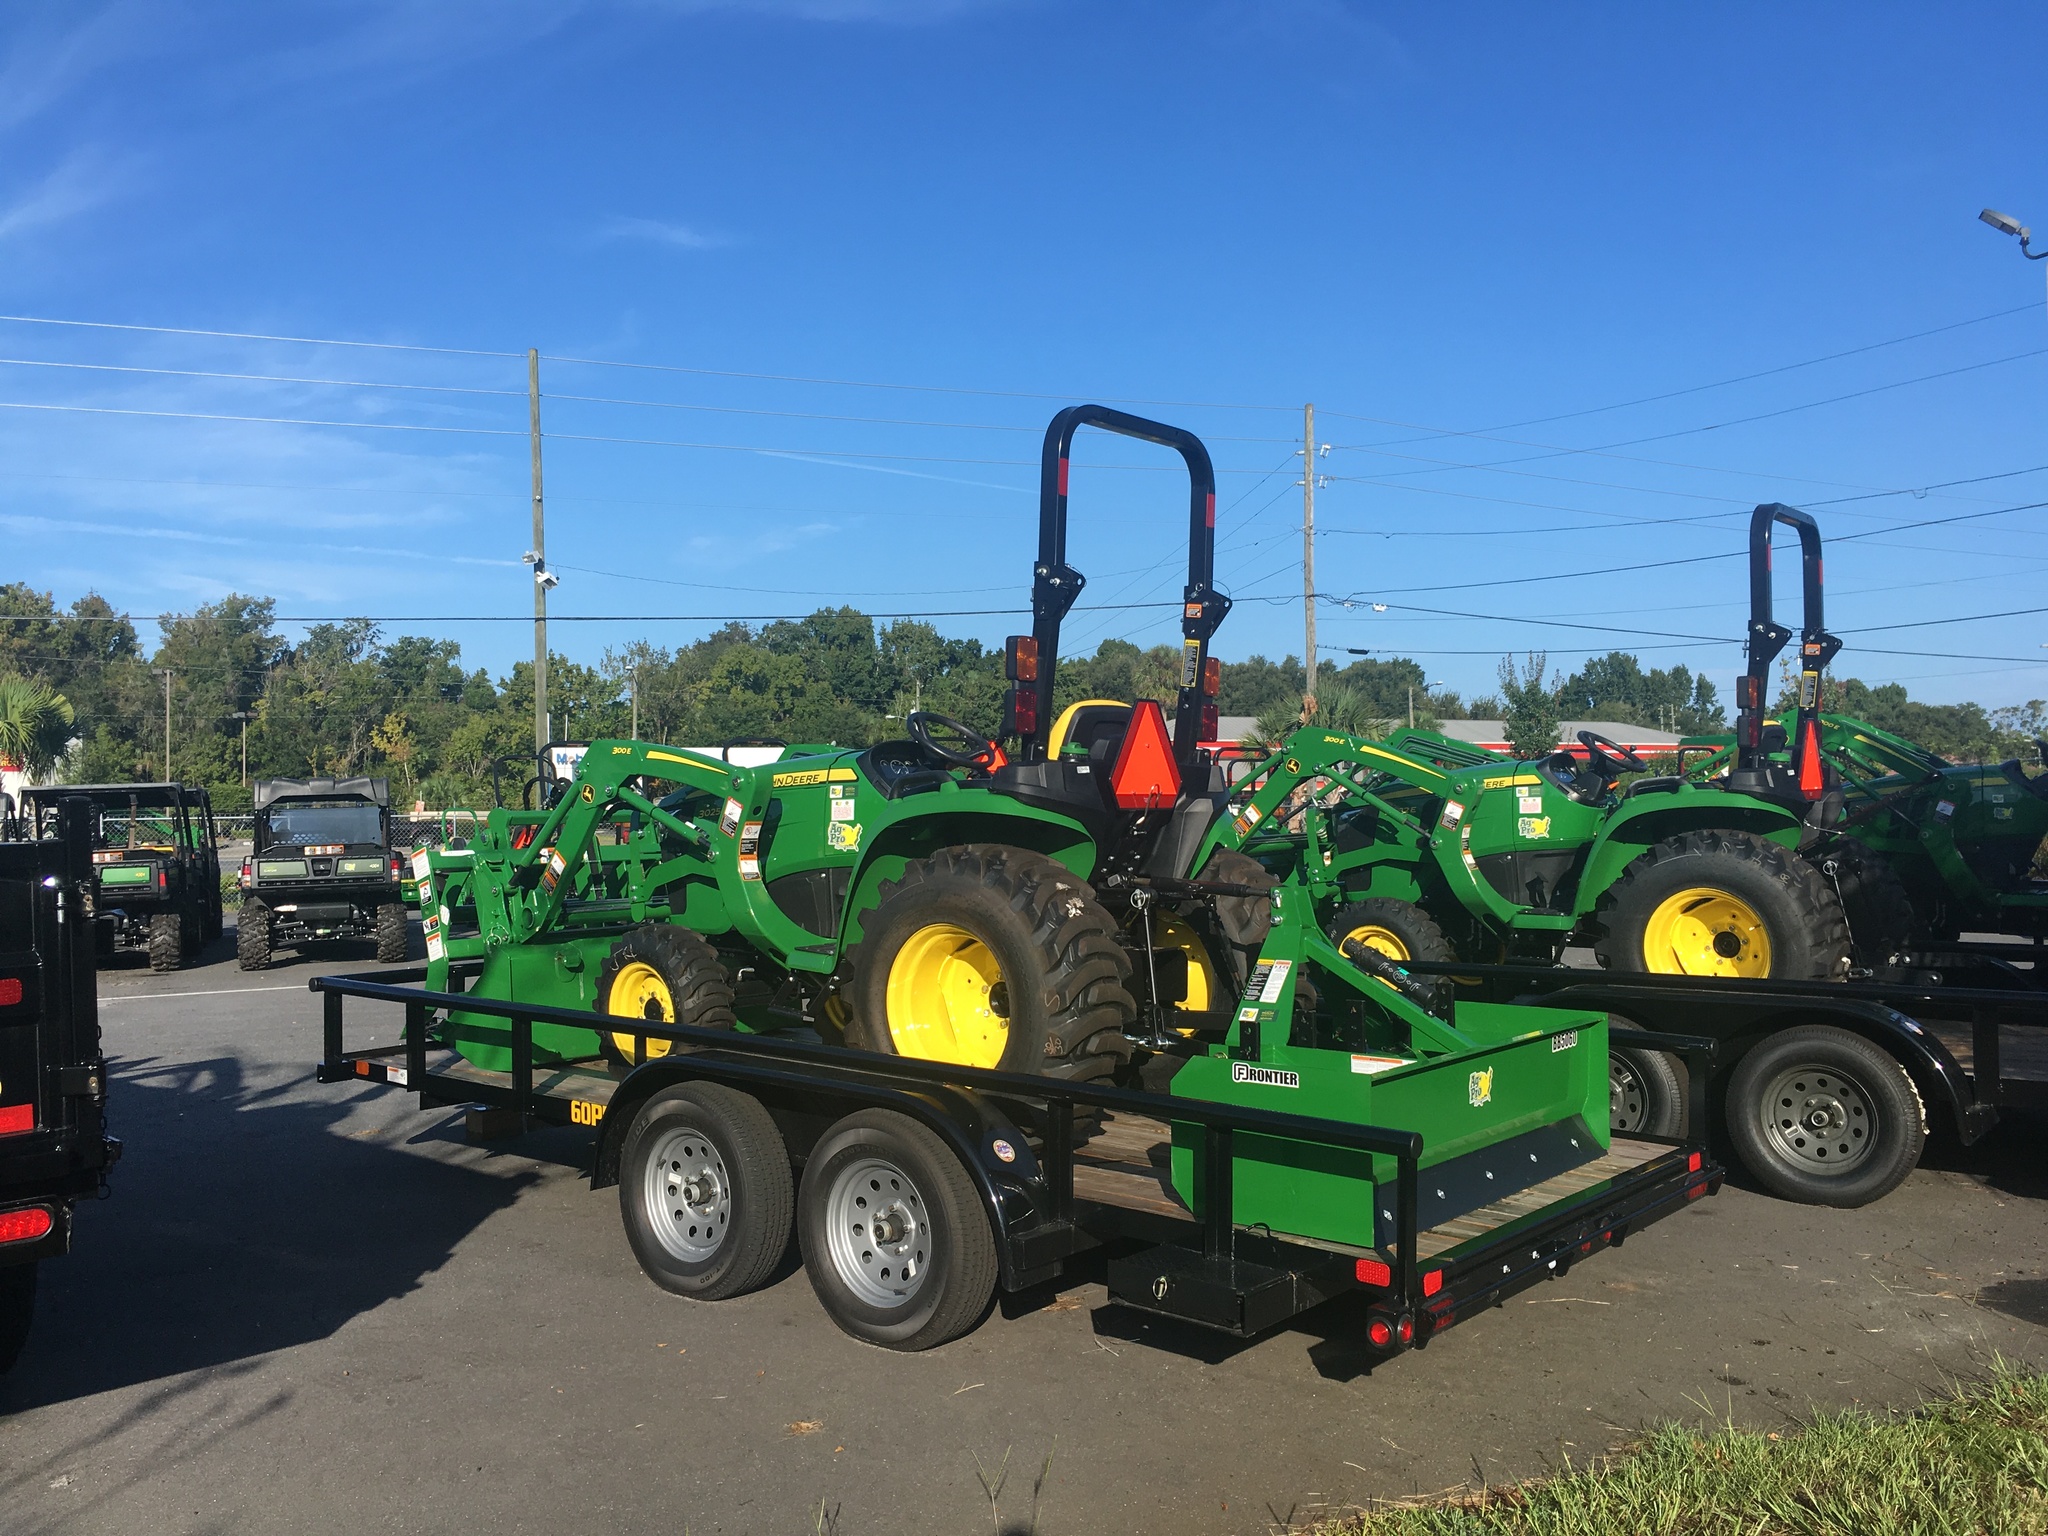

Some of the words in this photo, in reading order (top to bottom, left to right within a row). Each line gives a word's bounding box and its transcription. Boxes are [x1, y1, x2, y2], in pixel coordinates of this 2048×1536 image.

[785, 774, 820, 785] DEERE
[1521, 827, 1536, 835] Pro
[830, 834, 846, 844] Pro
[1233, 1063, 1299, 1087] FRONTIER
[570, 1099, 607, 1127] 60P
